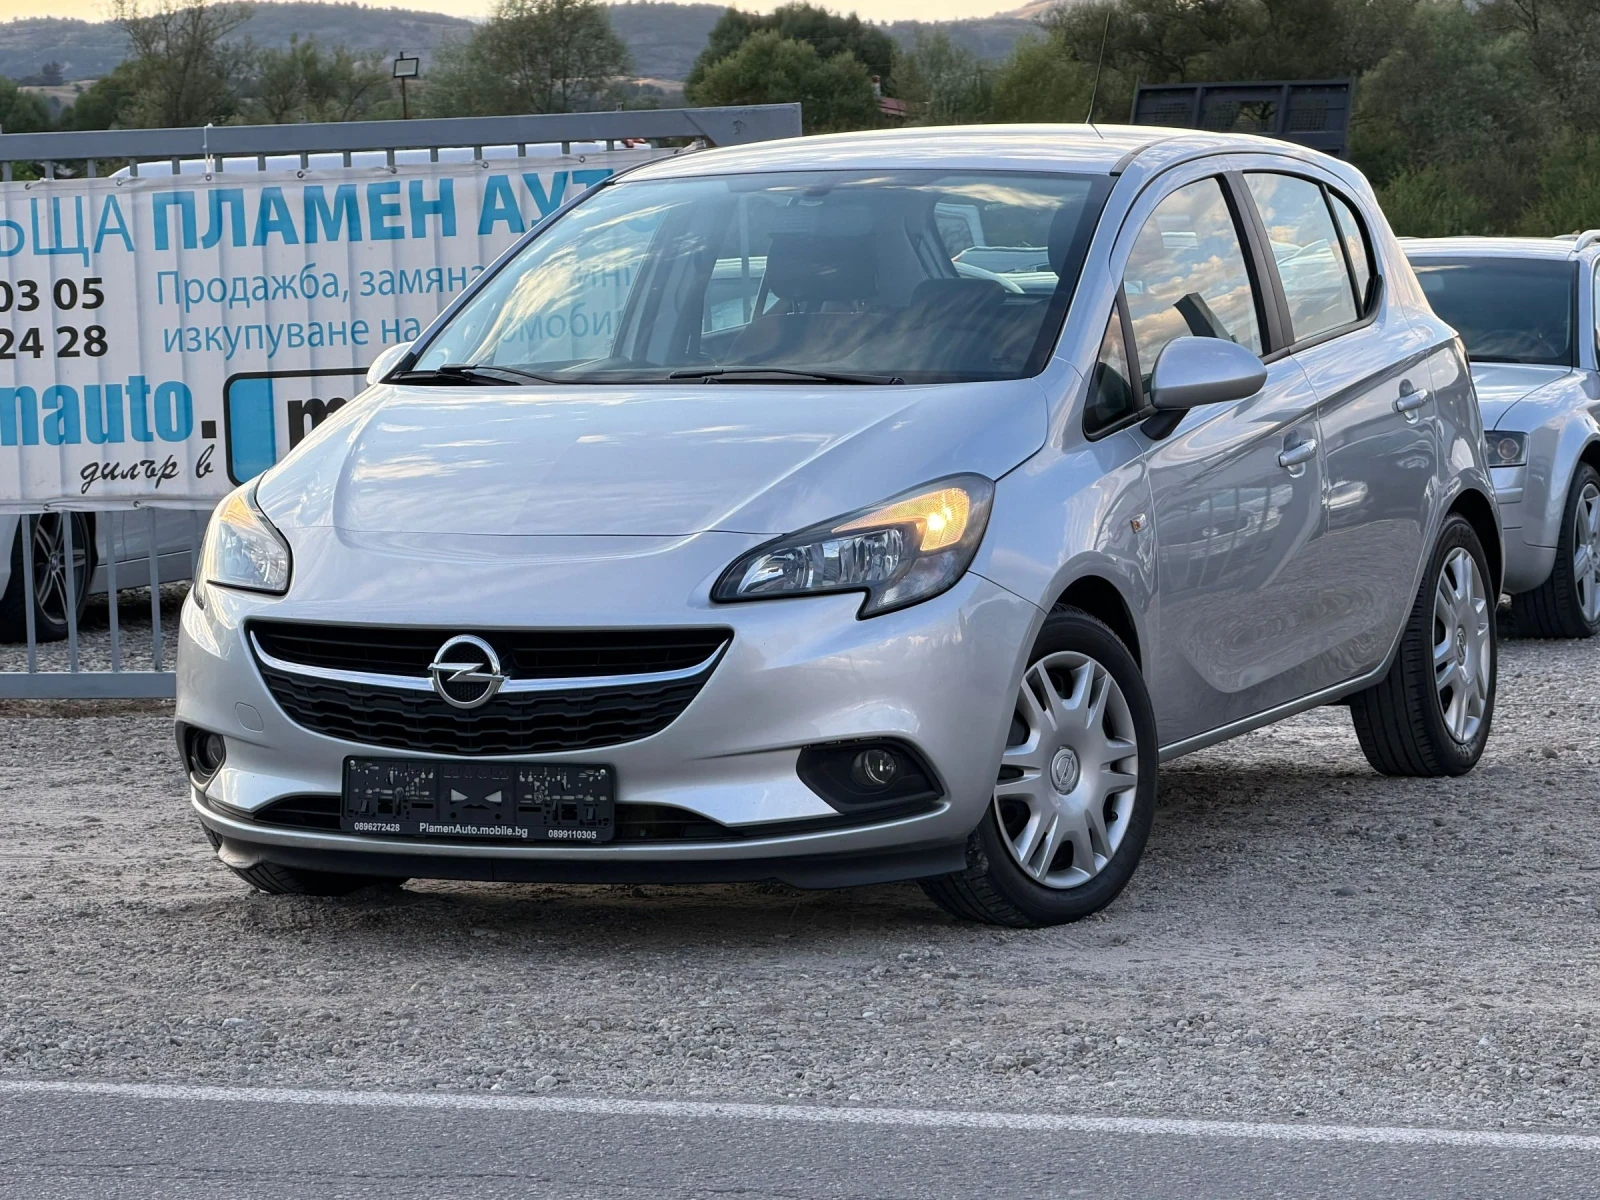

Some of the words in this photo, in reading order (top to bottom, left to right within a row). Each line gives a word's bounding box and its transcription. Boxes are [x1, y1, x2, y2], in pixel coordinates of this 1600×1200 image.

[152, 179, 456, 251] ПЛАМЕН
[53, 277, 105, 310] 05
[157, 262, 348, 313] Продажба,
[56, 325, 108, 358] 28
[163, 319, 368, 361] изкупуване
[381, 317, 421, 344] на
[354, 822, 400, 832] 0896272428
[419, 822, 528, 838] PlamenAuto.mobile.bg
[548, 829, 597, 839] 0899110305
